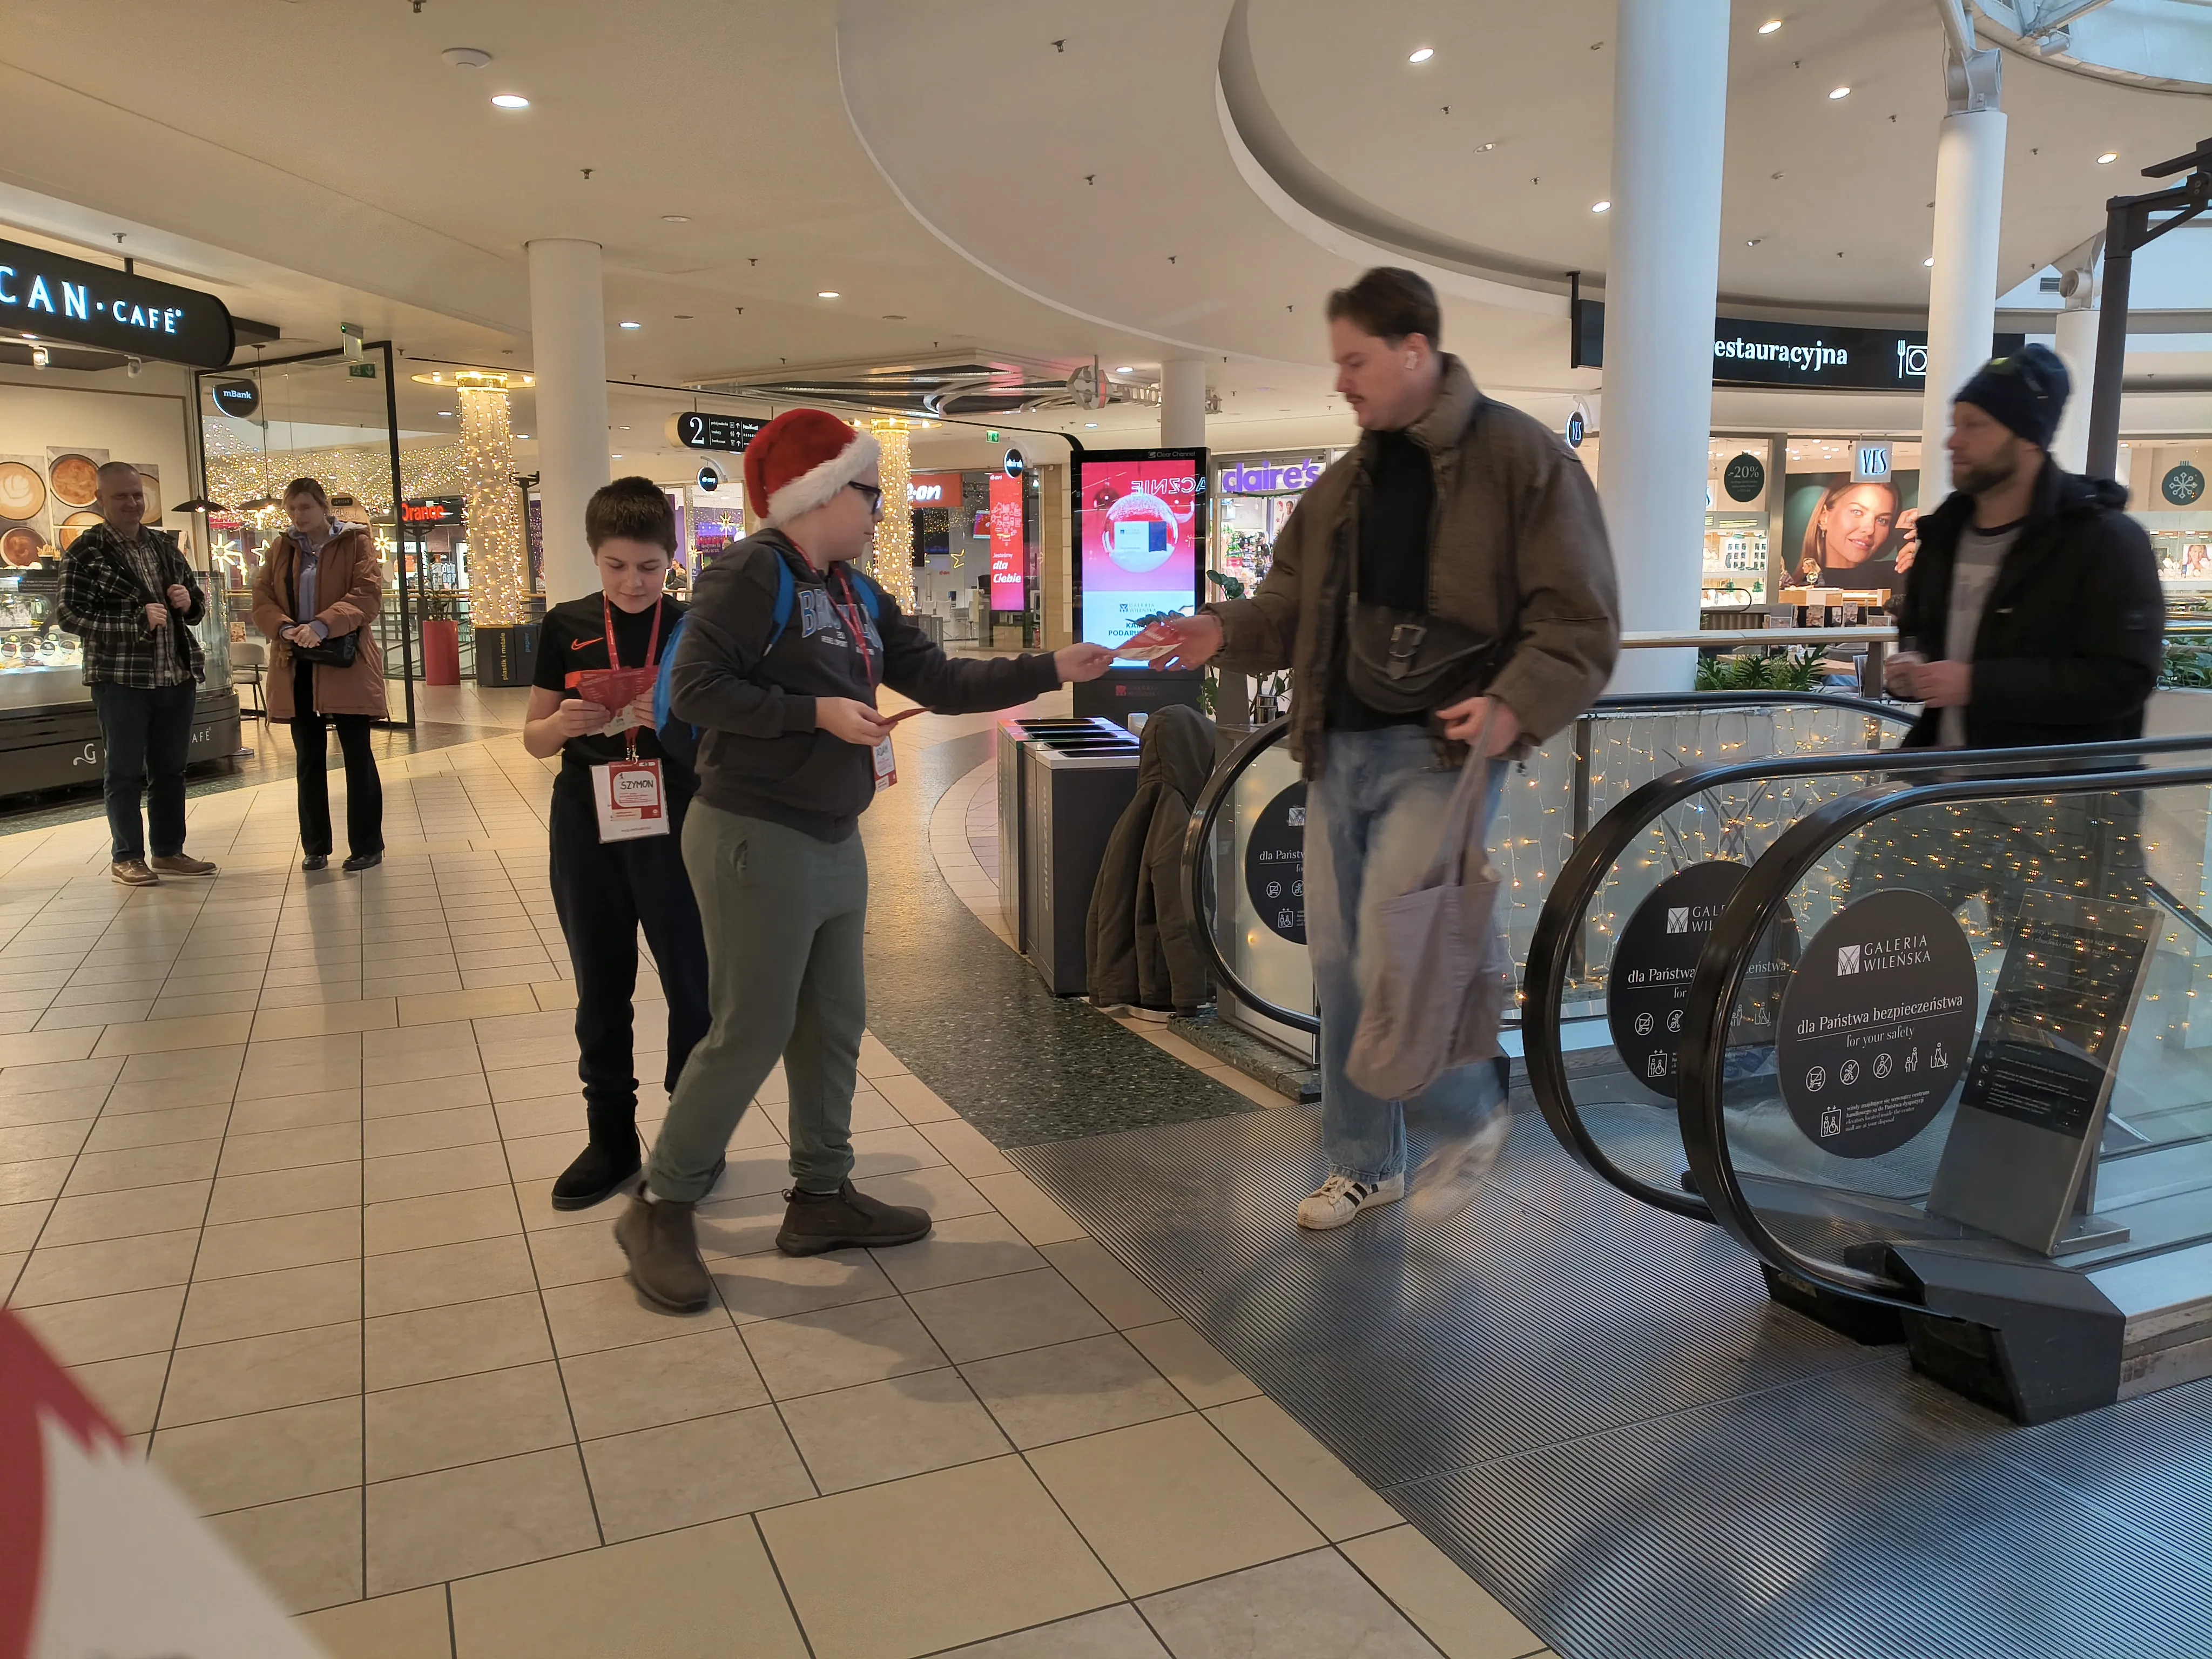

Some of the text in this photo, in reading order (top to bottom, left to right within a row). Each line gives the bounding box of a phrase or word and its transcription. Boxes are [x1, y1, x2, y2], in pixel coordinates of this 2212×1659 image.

[1713, 338, 1847, 371] estauracyjna
[223, 390, 252, 399] mBank
[690, 417, 704, 444] 2
[1572, 420, 1582, 441] YES
[1863, 449, 1887, 474] YES
[1222, 458, 1321, 493] claire's
[1728, 466, 1759, 478] -20%
[993, 561, 1009, 570] dla
[993, 572, 1021, 583] Ciebie
[192, 728, 210, 743] AFÉ
[620, 780, 653, 790] SZYMON
[1259, 851, 1273, 860] dla
[1864, 935, 1927, 955] GALERIA
[1864, 950, 1931, 971] WILEŃSKA
[1628, 970, 1644, 983] dla
[1649, 967, 1695, 981] Państwa
[1674, 987, 1687, 999] for
[1797, 995, 1963, 1035] dla Państwa bezpieczeństwa
[1846, 1025, 1915, 1048] for your safety
